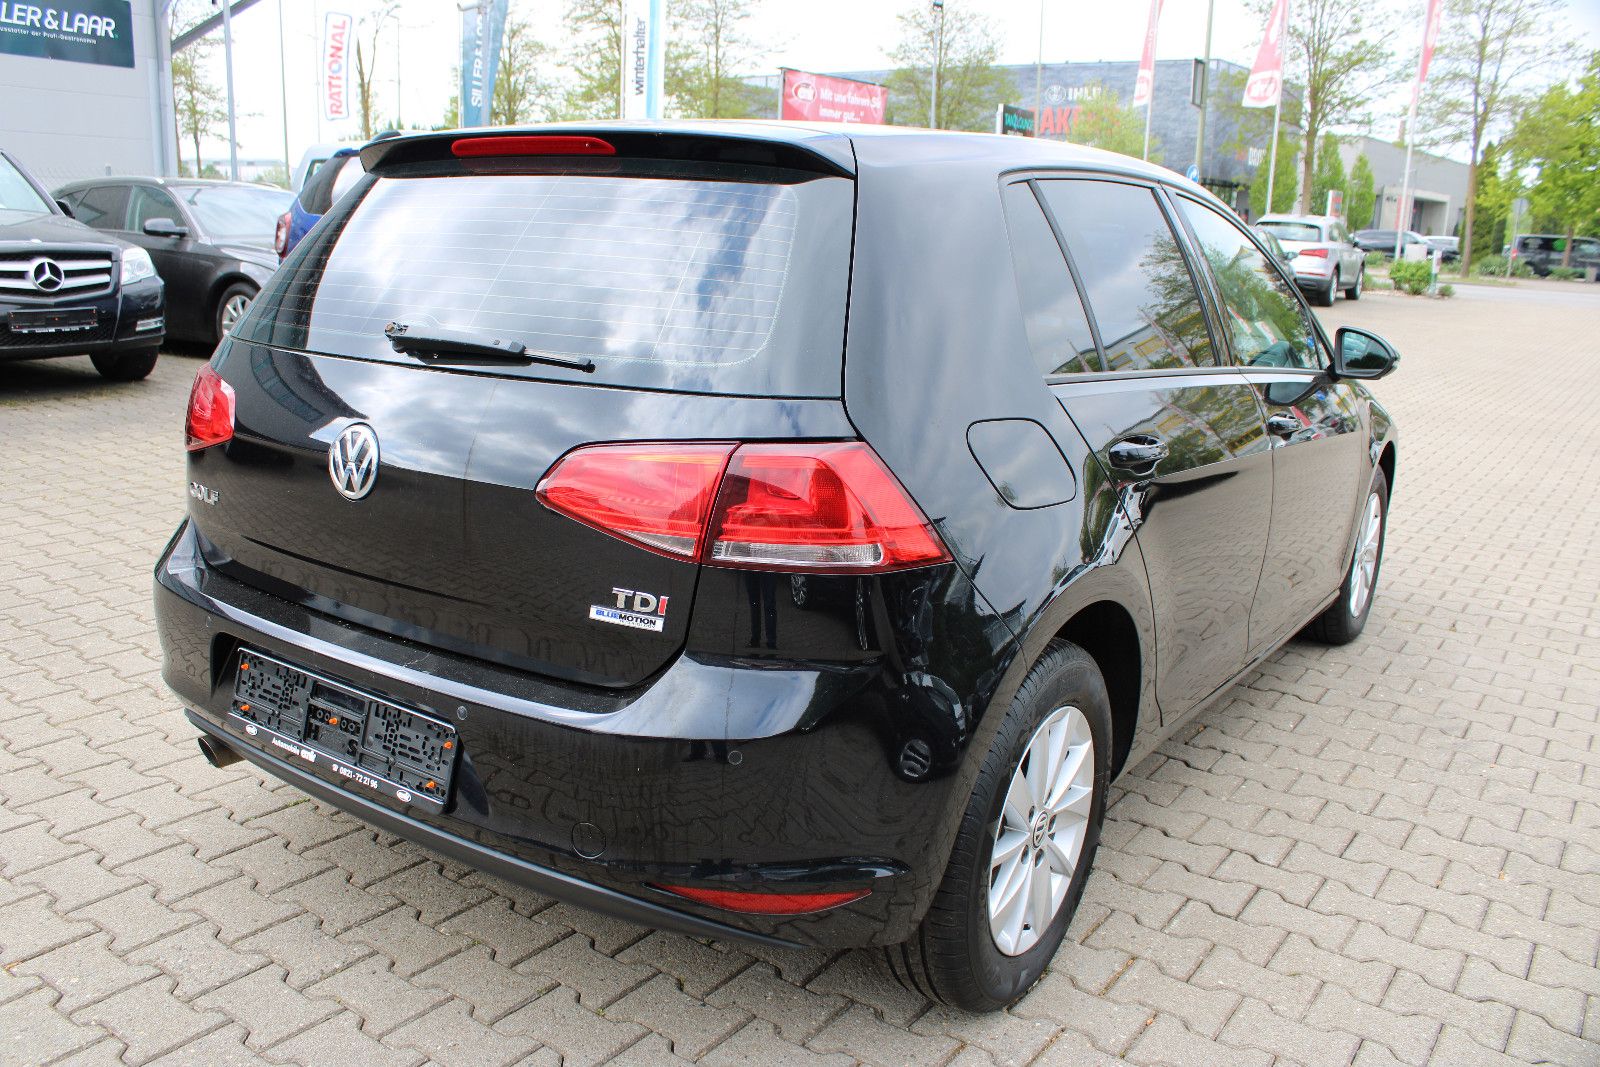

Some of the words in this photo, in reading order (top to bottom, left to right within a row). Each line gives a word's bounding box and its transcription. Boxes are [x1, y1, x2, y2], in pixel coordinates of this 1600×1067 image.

[327, 19, 347, 116] RATIONAL
[632, 17, 646, 96] winterhalter
[595, 609, 657, 626] BLUEMOTION
[612, 587, 670, 616] TDI
